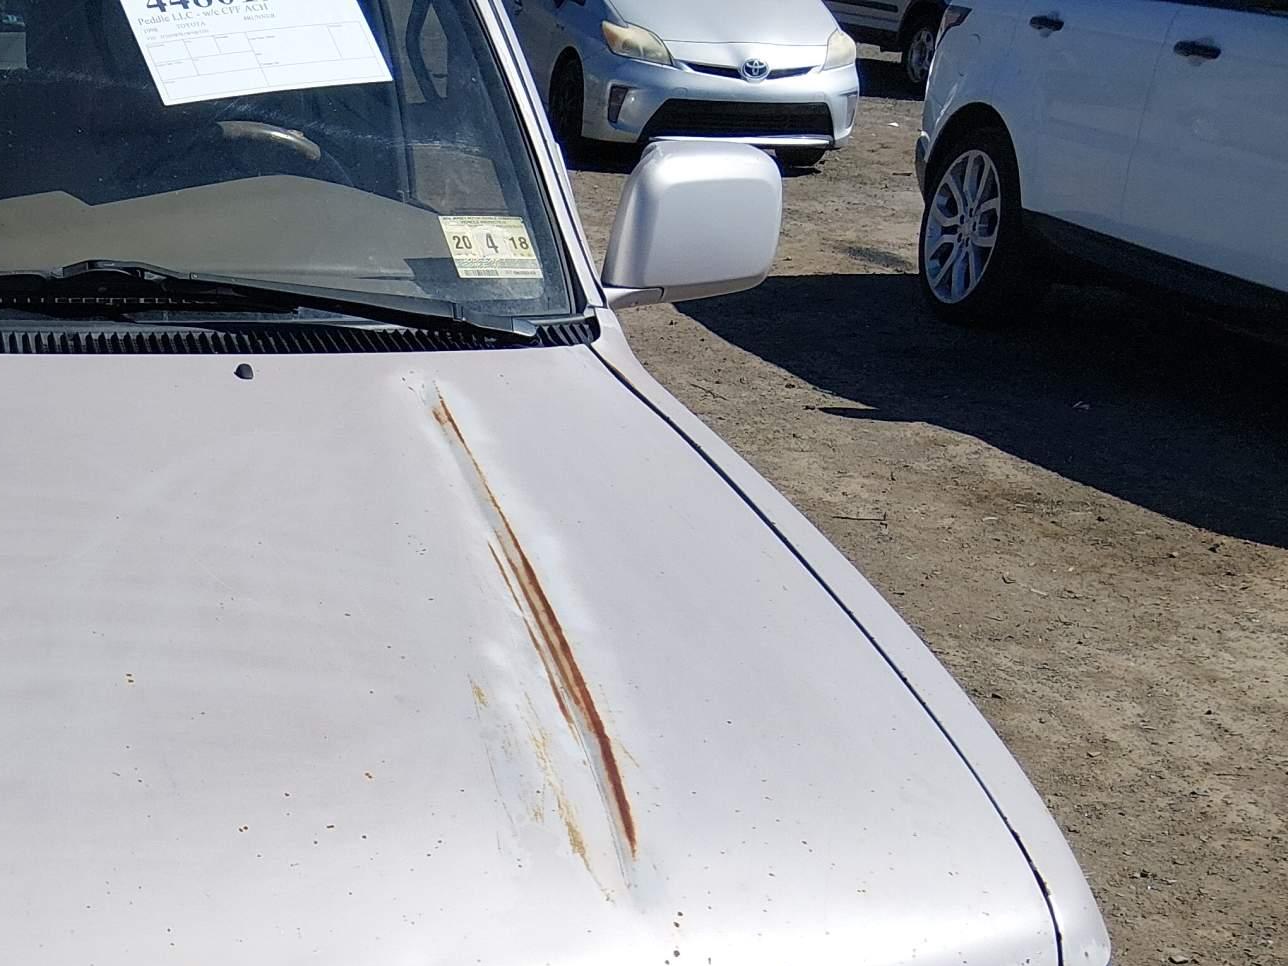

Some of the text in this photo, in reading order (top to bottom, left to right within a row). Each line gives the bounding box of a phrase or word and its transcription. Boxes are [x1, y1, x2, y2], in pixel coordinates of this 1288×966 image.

[138, 15, 171, 26] Peddle
[172, 11, 193, 21] LLC
[245, 3, 269, 12] ACH
[176, 21, 207, 30] TOYOTA
[453, 233, 529, 253] 20 4 18
